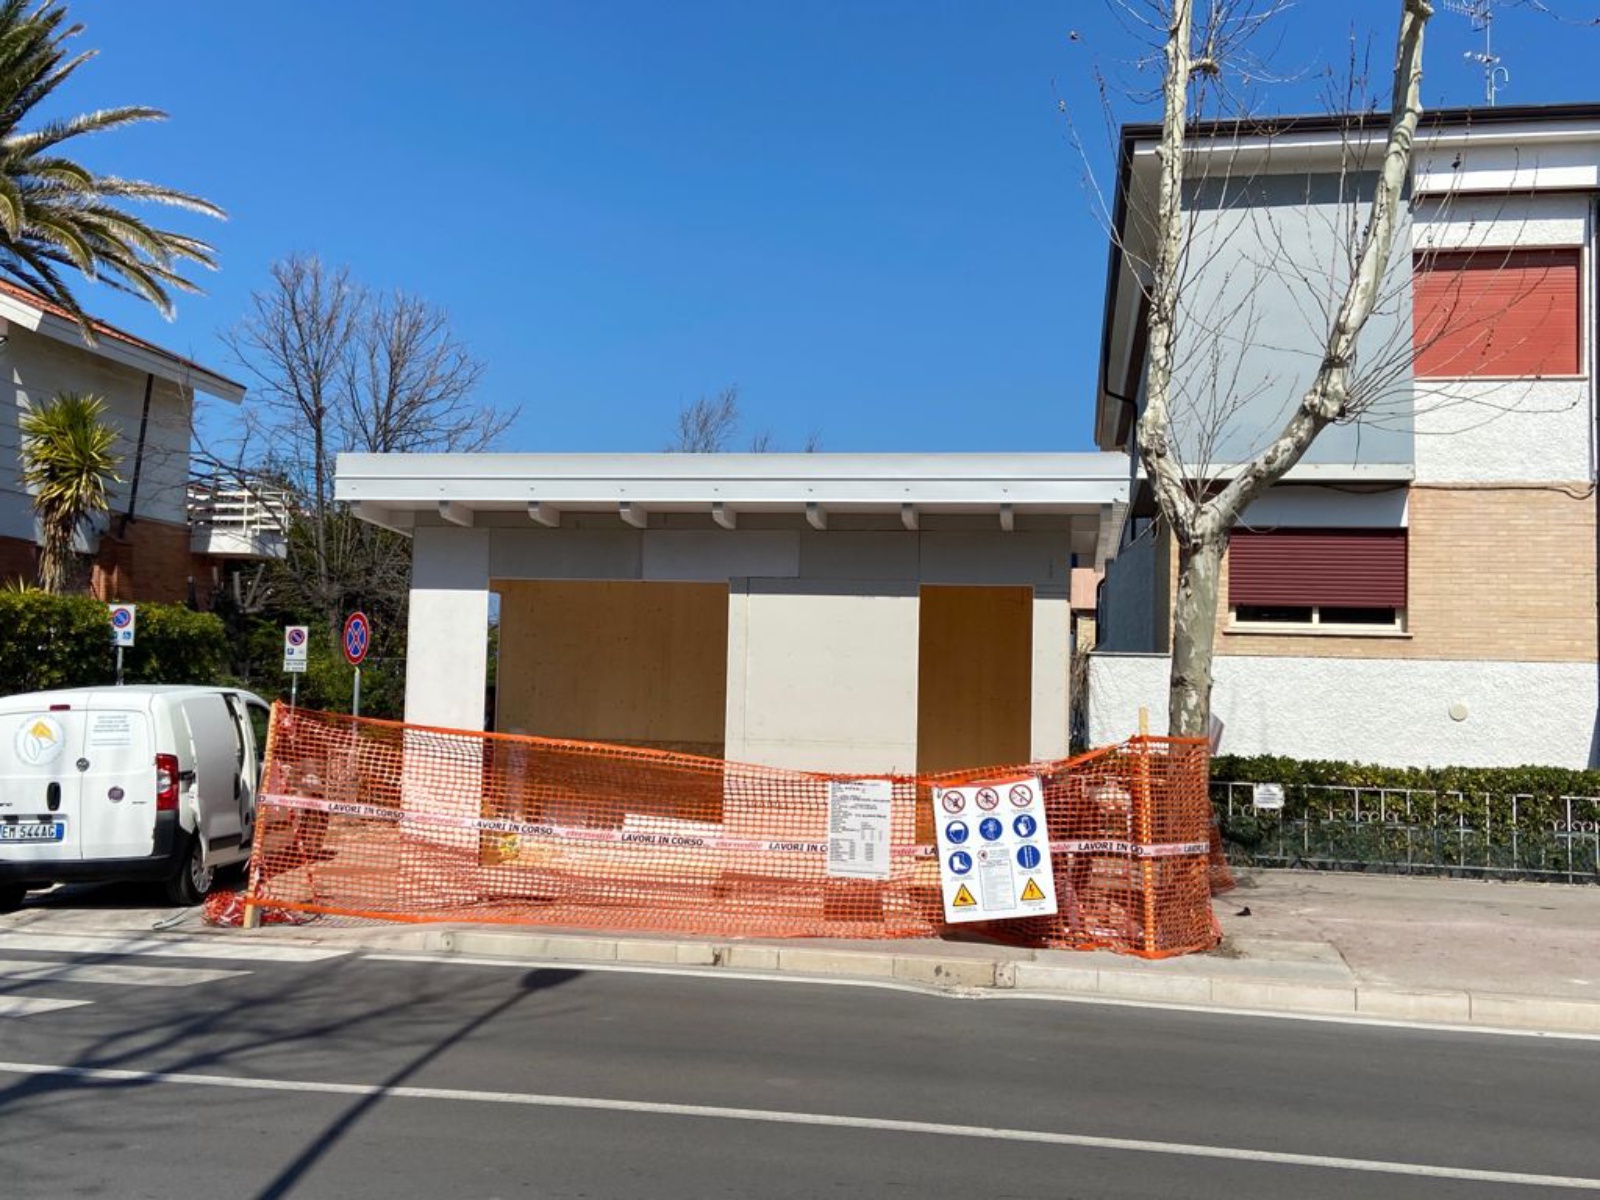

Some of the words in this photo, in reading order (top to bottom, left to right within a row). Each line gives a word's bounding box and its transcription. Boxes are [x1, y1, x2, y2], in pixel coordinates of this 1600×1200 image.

[328, 803, 361, 813] LAVORI
[363, 806, 374, 815] IN
[376, 808, 405, 820] CORSO
[20, 825, 54, 838] 544AG
[472, 821, 506, 831] LAVORI
[508, 823, 520, 832] IN
[521, 824, 553, 835] CORSO
[621, 833, 656, 843] LAVORI
[658, 836, 670, 844] IN
[671, 837, 704, 846] CORSO
[1078, 841, 1113, 851] LAVORI
[1116, 843, 1128, 851] IN
[769, 842, 804, 851] LAVORI
[806, 843, 818, 852] IN
